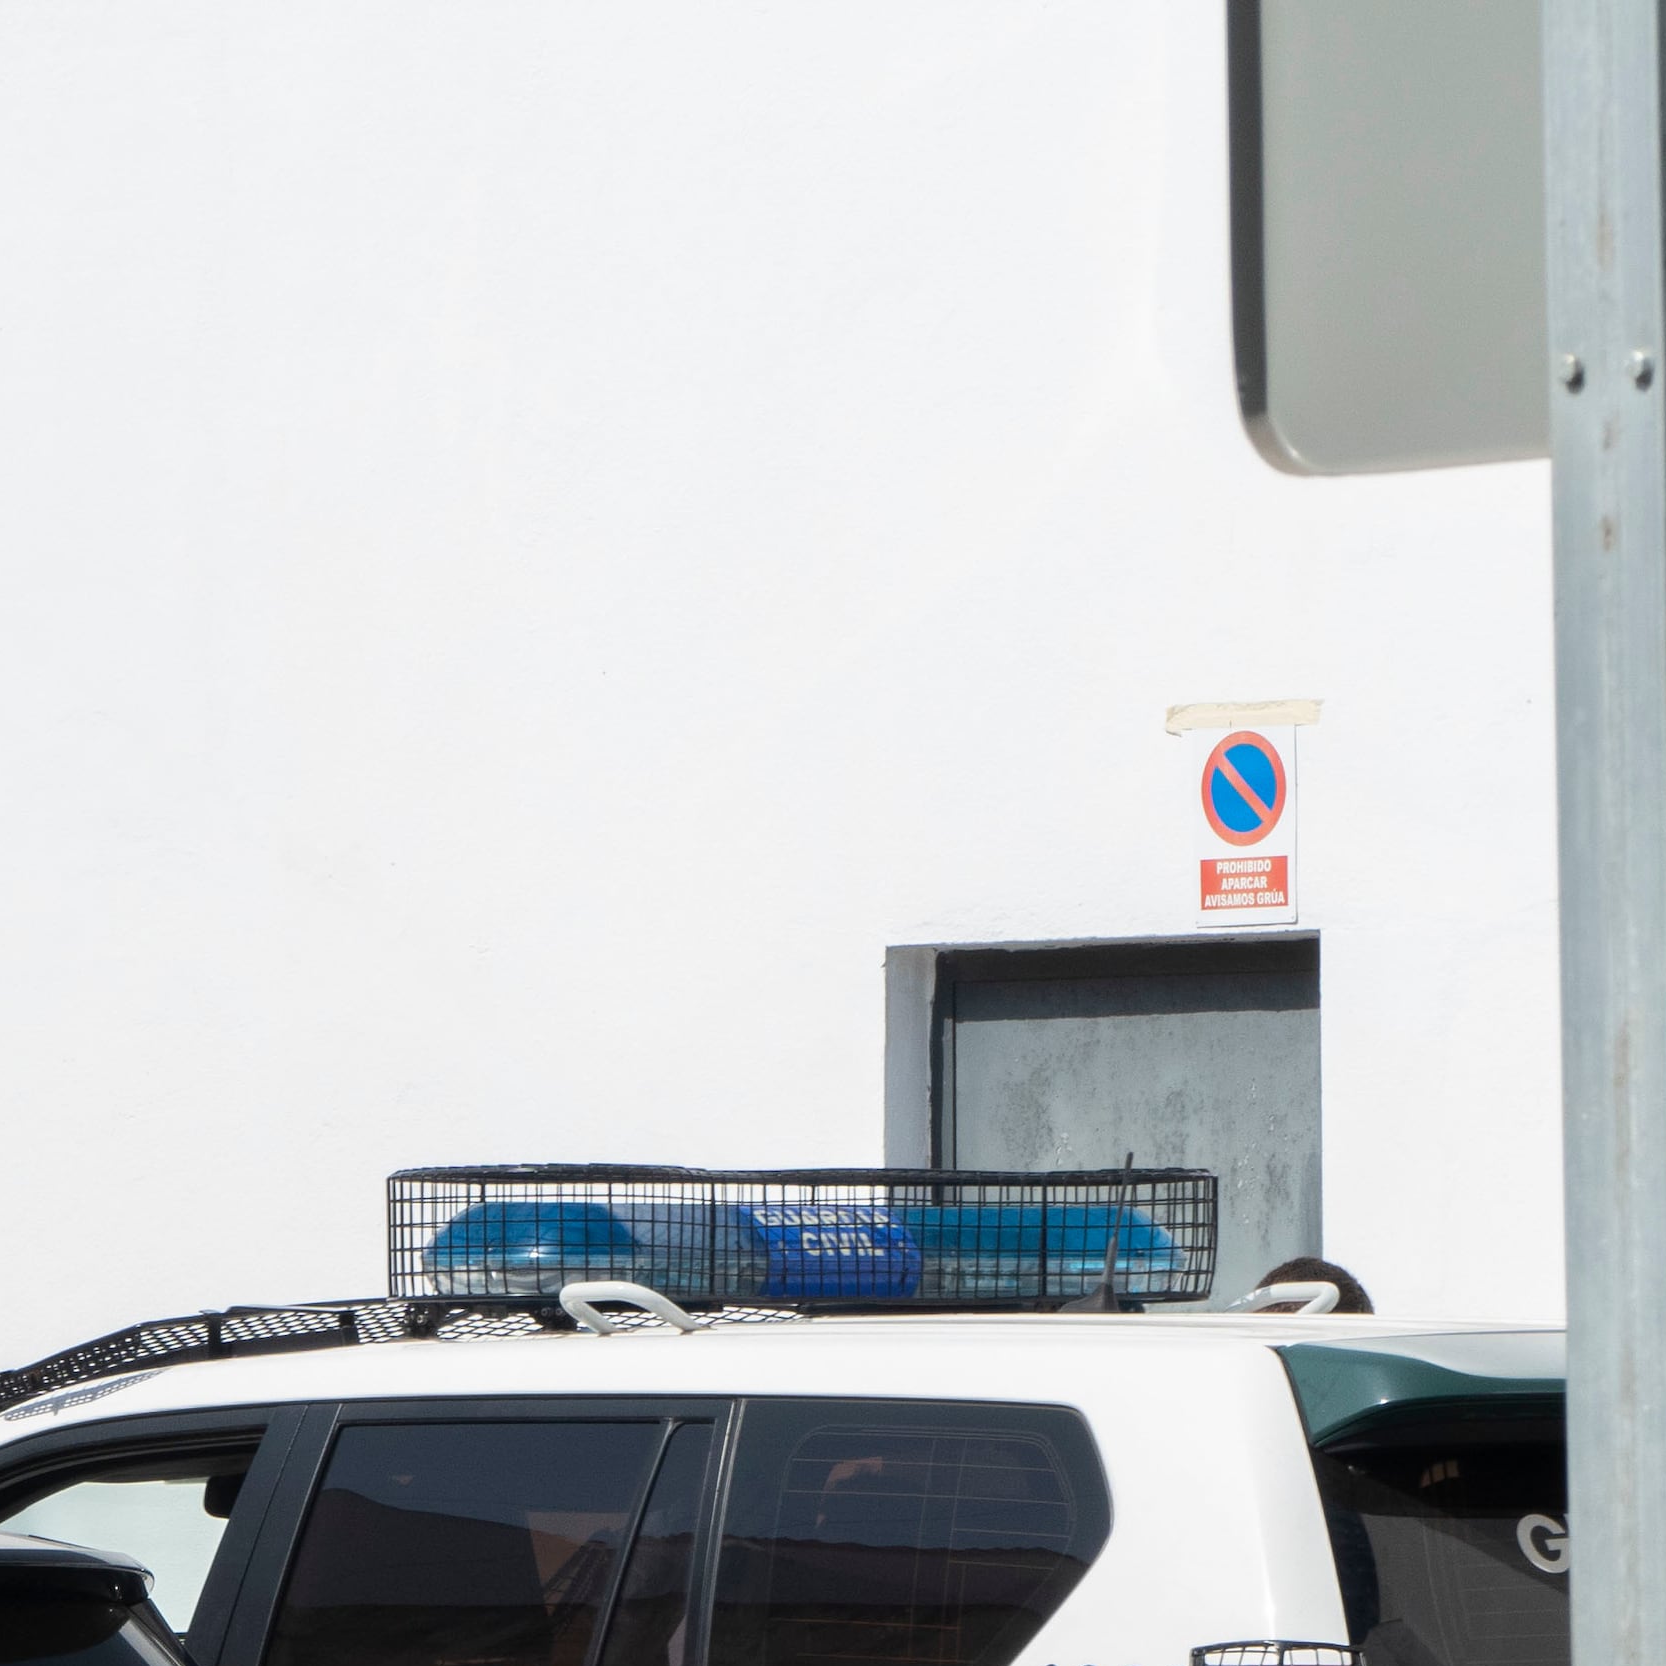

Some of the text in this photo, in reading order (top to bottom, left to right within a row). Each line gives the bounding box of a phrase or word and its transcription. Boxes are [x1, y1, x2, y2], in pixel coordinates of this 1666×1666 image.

[1216, 858, 1272, 875] PROHIBIDO
[1221, 876, 1268, 891] APARCAR
[1204, 888, 1286, 908] AVISAMOS GRÚA
[802, 1232, 885, 1257] CIVIL
